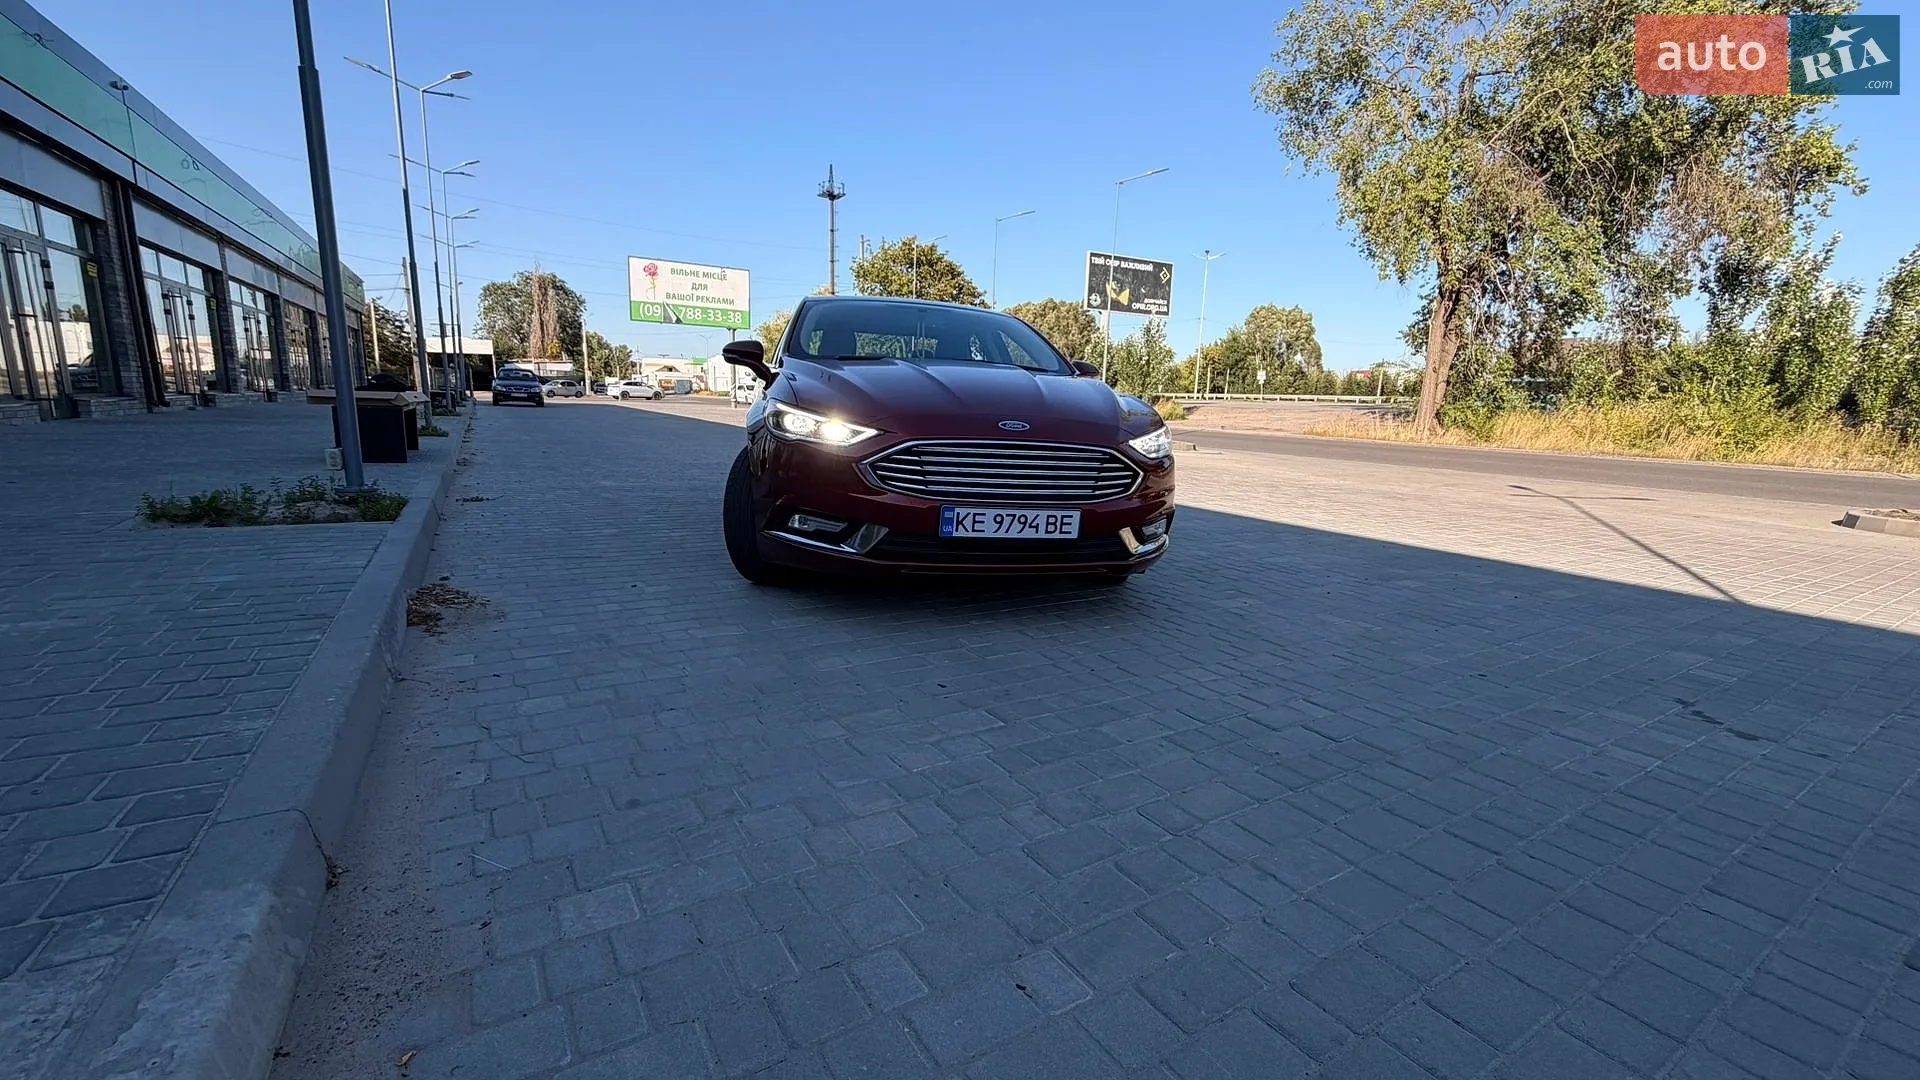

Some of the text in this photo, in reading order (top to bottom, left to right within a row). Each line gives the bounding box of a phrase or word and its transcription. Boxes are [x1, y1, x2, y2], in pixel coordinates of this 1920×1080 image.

[670, 267, 728, 282] ВІЛЬНЕ МІСЦЕ
[691, 282, 708, 291] ДЛЯ
[665, 292, 735, 307] ВАШОЇ РЕКЛАМИ
[678, 306, 743, 324] 788-33-38
[955, 511, 1074, 535] KE 9794 BE
